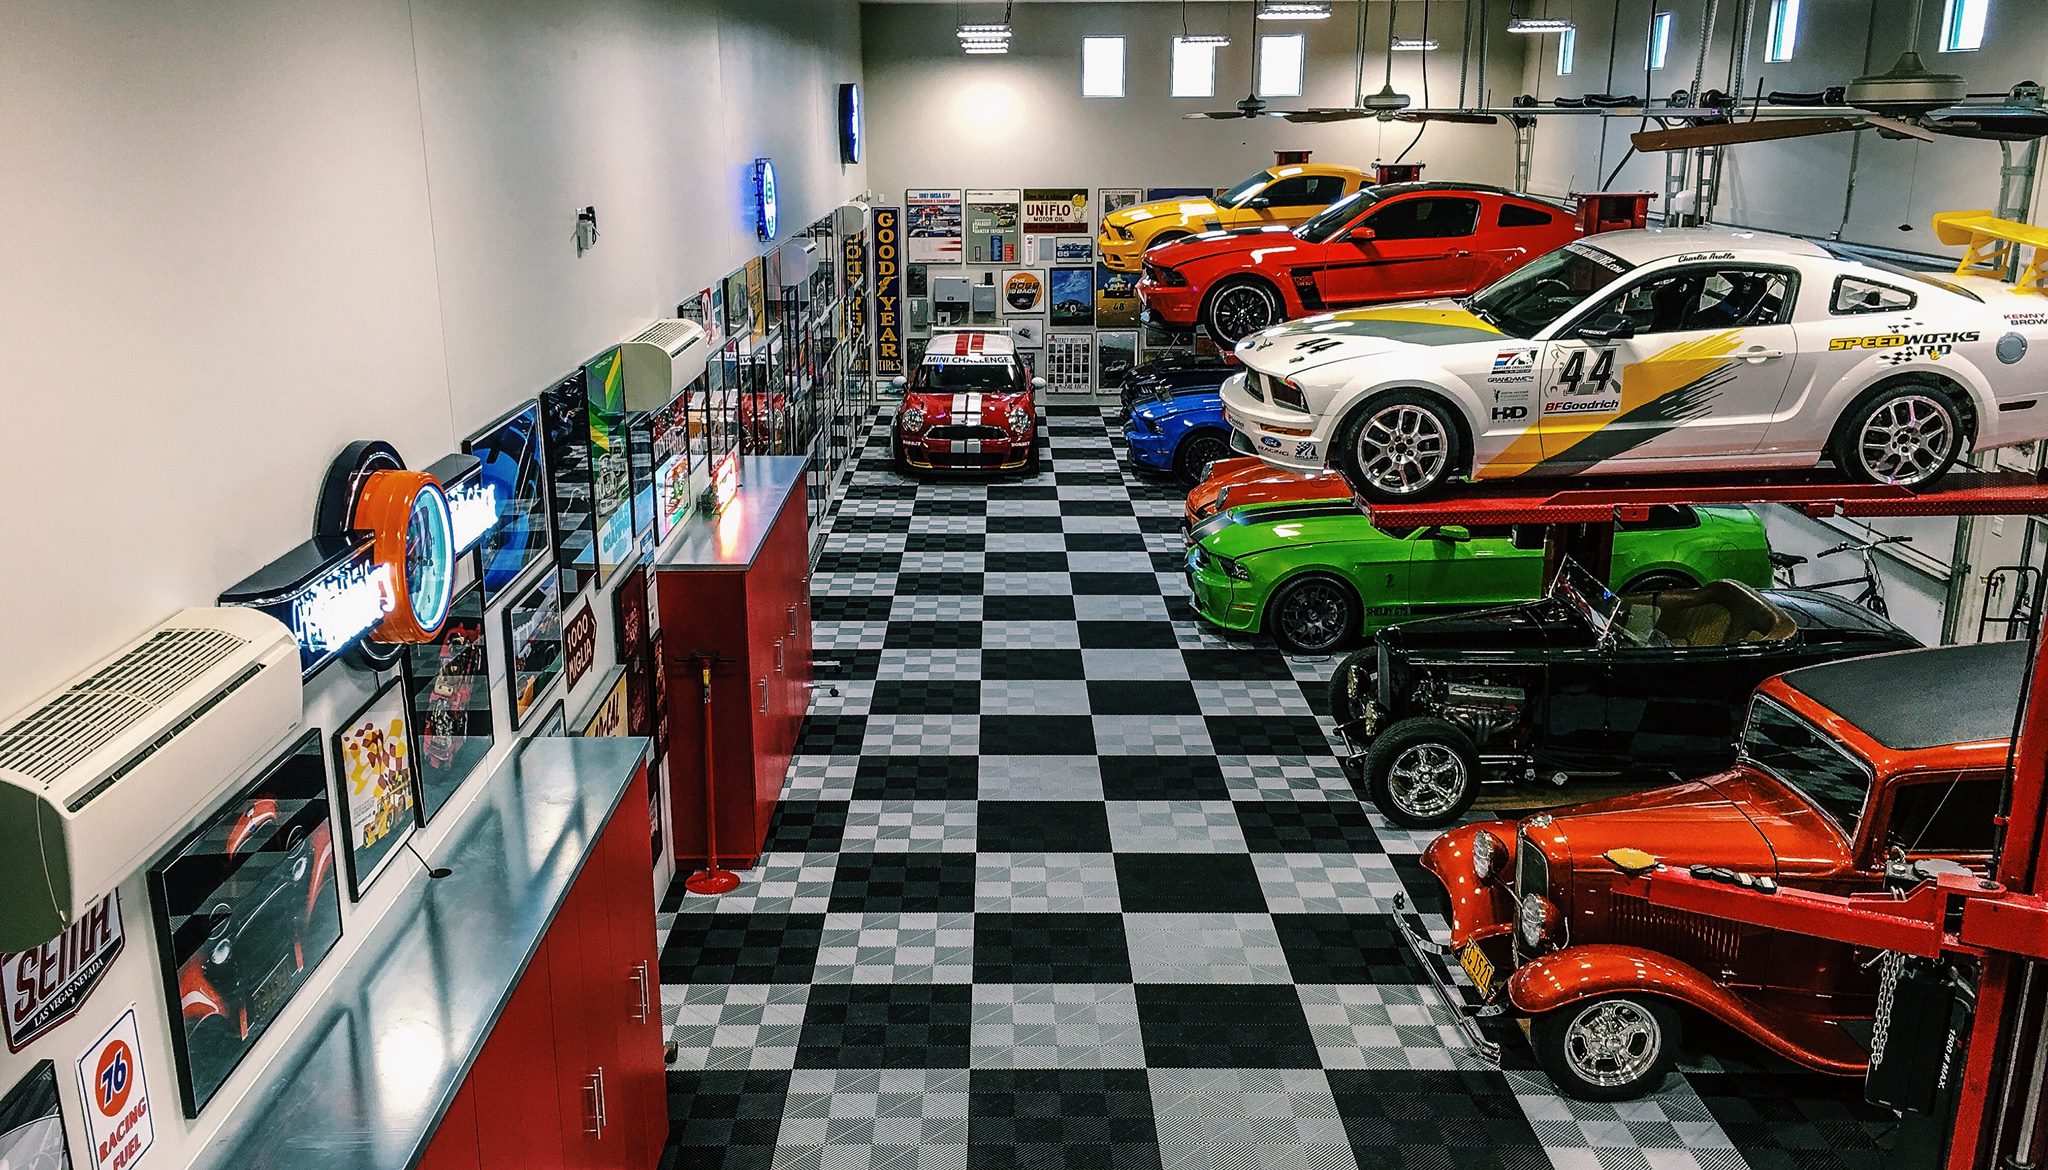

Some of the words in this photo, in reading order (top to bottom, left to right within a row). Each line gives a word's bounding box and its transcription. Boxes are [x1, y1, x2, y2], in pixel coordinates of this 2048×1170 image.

[1026, 204, 1071, 216] UNIFLO
[1678, 253, 1708, 262] Charlie
[1010, 282, 1039, 290] BOSS
[878, 359, 901, 371] TIRES
[1558, 348, 1617, 396] 44
[1545, 400, 1620, 412] BFGoodrich
[1257, 445, 1289, 456] RACING
[567, 614, 588, 653] 1000
[568, 638, 592, 684] MIGLIA
[33, 1007, 50, 1027] LAS
[48, 984, 75, 1012] VEGAS
[73, 958, 105, 991] NEVADA
[1945, 1028, 1957, 1054] 1500
[101, 1048, 127, 1106] 76
[1937, 1061, 1949, 1090] MAX.
[98, 1096, 147, 1164] RACING
[112, 1133, 142, 1170] FUEL
